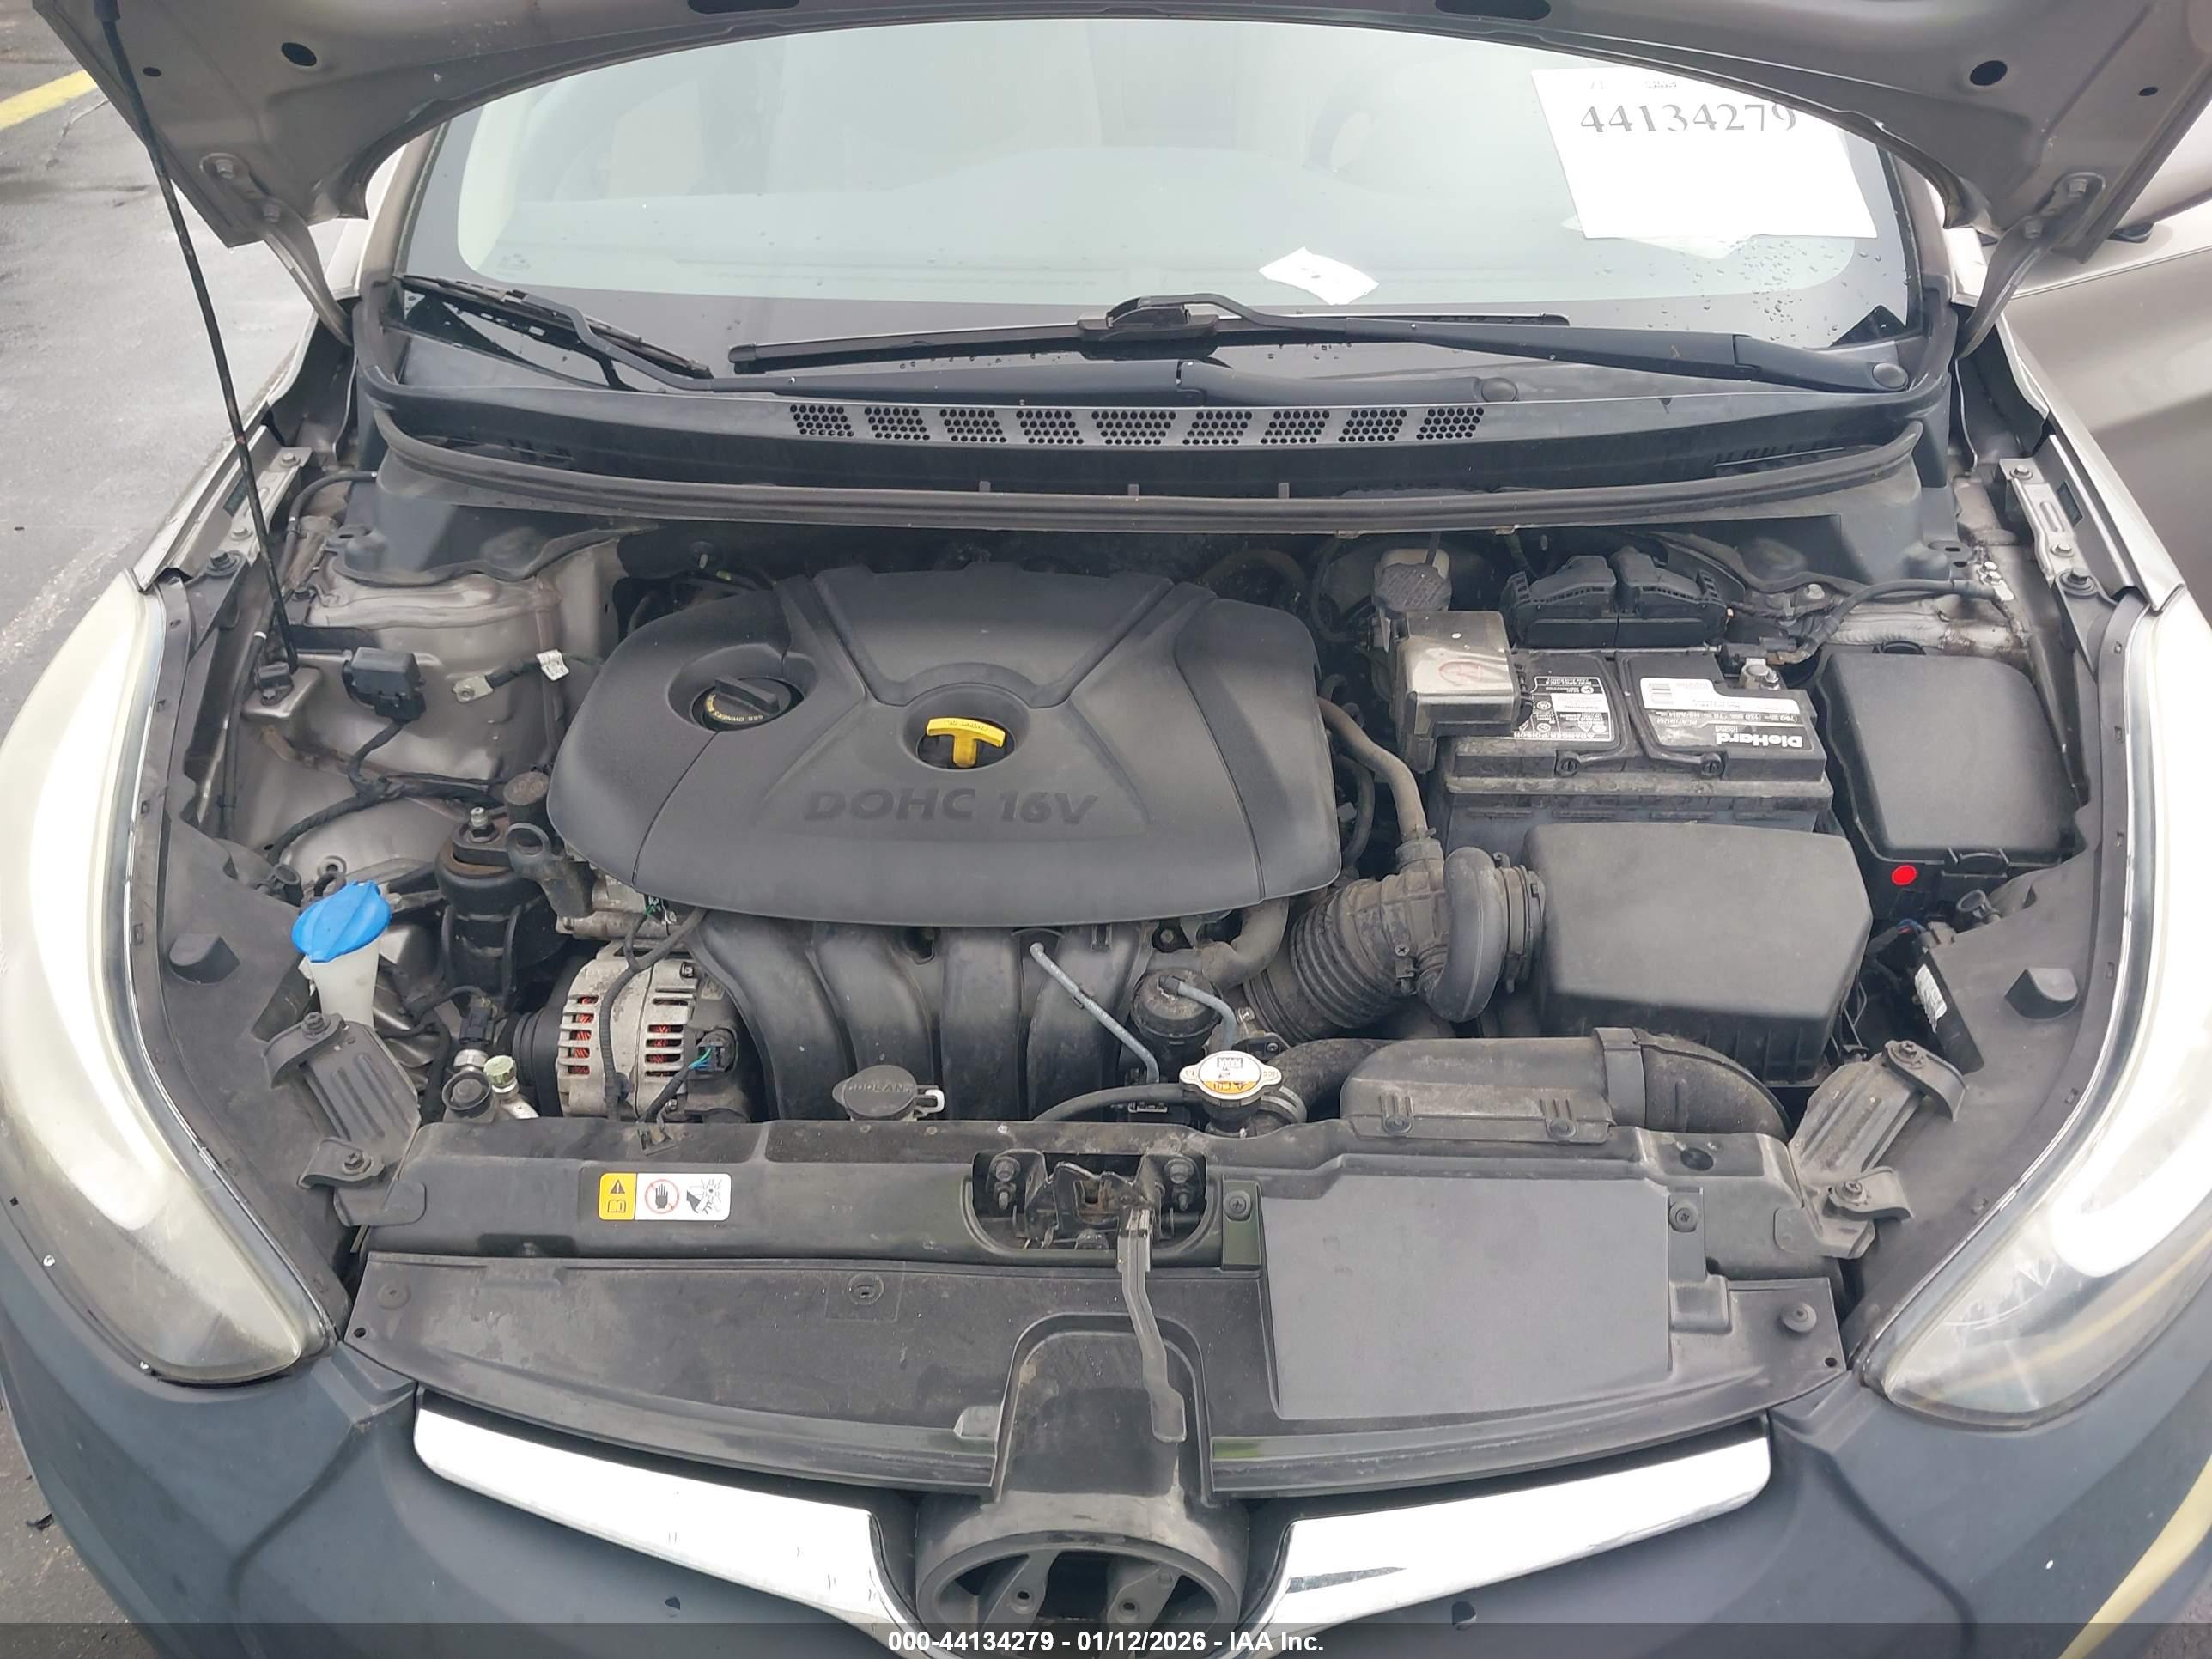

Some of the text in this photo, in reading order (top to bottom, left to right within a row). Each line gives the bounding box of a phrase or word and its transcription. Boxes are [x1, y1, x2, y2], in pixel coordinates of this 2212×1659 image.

[1580, 103, 1796, 133] 44134279
[1716, 732, 1803, 749] DieHard
[803, 787, 1101, 824] DOHC 16V
